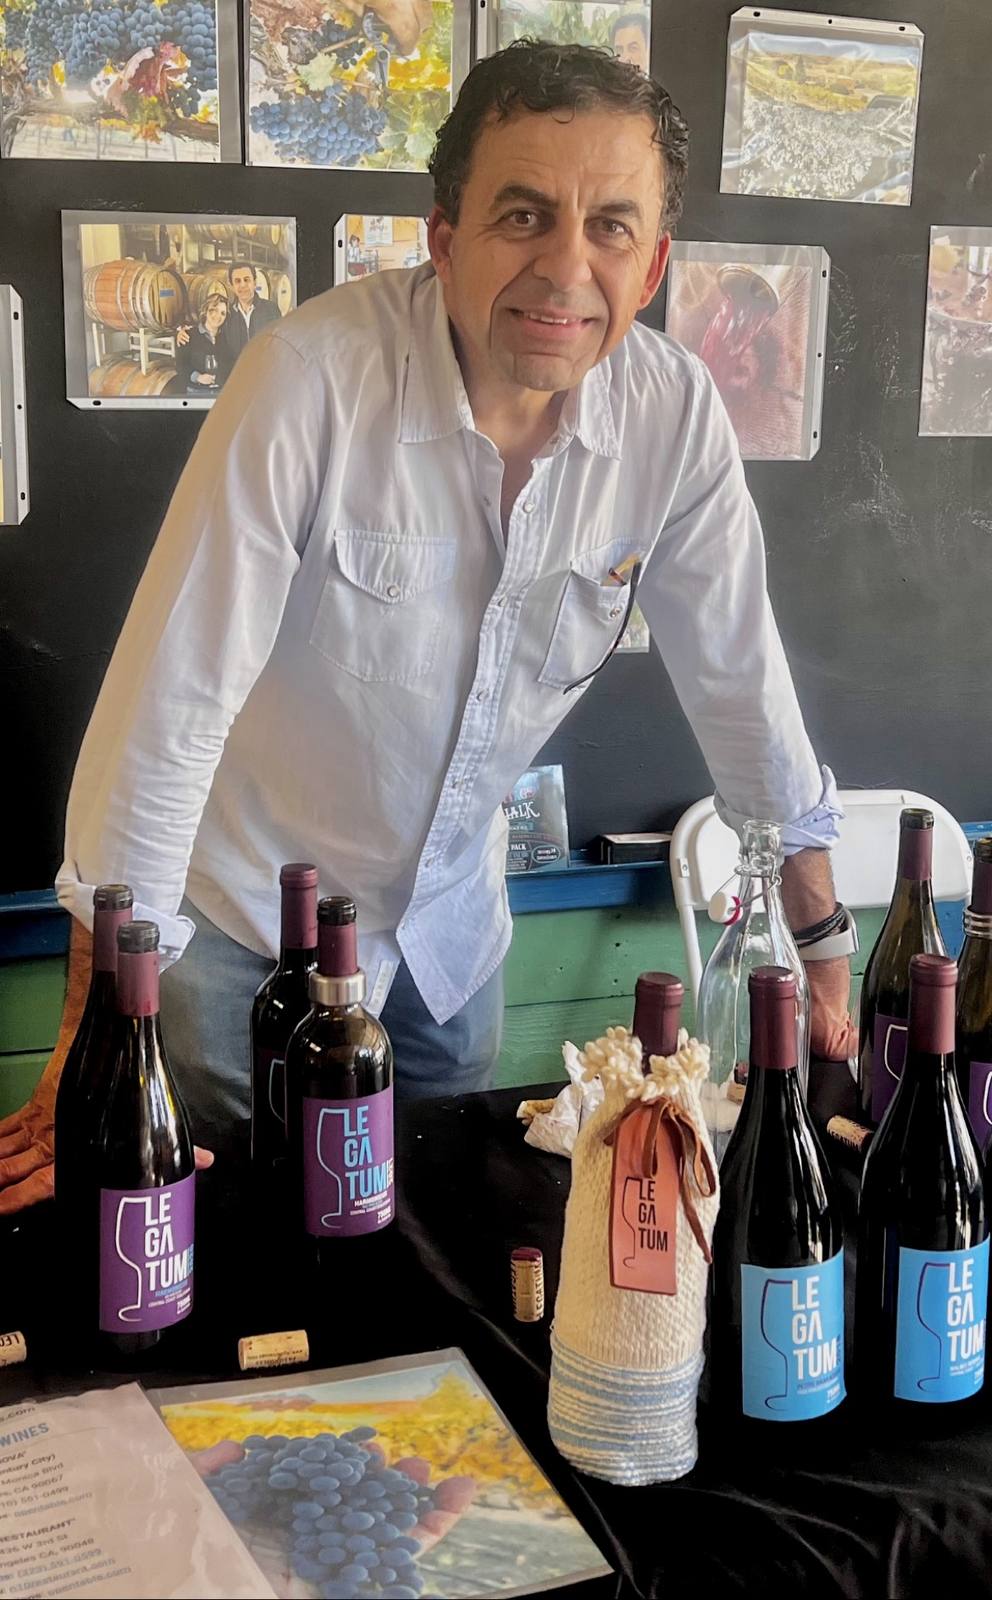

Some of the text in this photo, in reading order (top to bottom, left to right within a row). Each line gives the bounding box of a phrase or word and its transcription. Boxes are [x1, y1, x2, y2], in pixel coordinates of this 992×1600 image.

[343, 1105, 370, 1137] LE
[343, 1136, 373, 1168] GA
[344, 1162, 387, 1200] TUM
[639, 1179, 656, 1201] LE
[144, 1192, 172, 1227] LE
[638, 1203, 657, 1225] GA
[144, 1223, 174, 1258] GA
[638, 1227, 668, 1252] TUM
[145, 1250, 188, 1291] TUM
[948, 1258, 974, 1293] LE
[792, 1276, 820, 1311] LE
[947, 1292, 974, 1327] GA
[791, 1310, 823, 1345] GA
[793, 1338, 838, 1380] TUM
[0, 1422, 49, 1447] WINES
